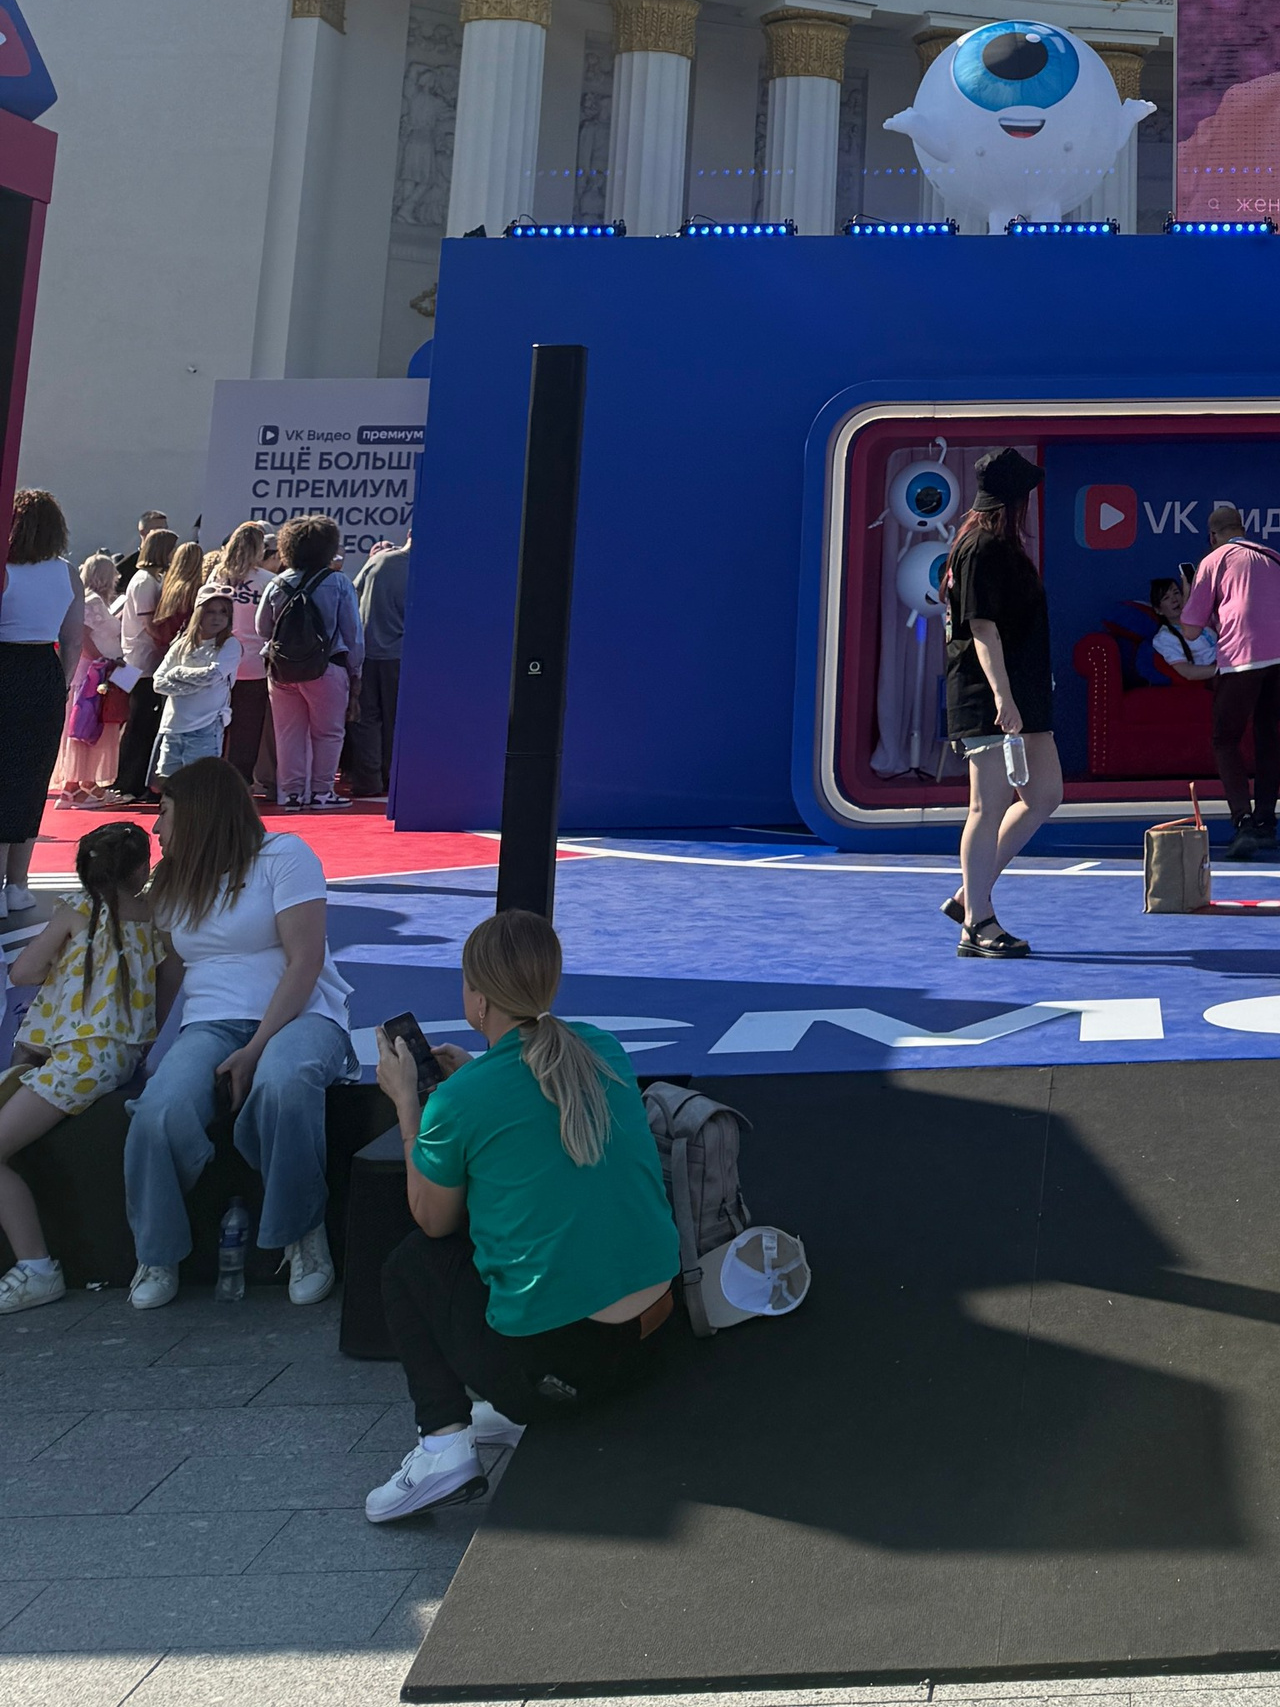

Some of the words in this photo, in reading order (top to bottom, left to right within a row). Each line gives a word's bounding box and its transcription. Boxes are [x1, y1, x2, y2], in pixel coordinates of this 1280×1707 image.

[285, 429, 305, 441] VK
[307, 429, 352, 443] Видео
[362, 430, 424, 441] премиум
[254, 446, 312, 475] ЕЩЁ
[251, 478, 271, 499] С
[276, 478, 408, 499] ПРЕМИУМ
[1143, 500, 1200, 534] VK
